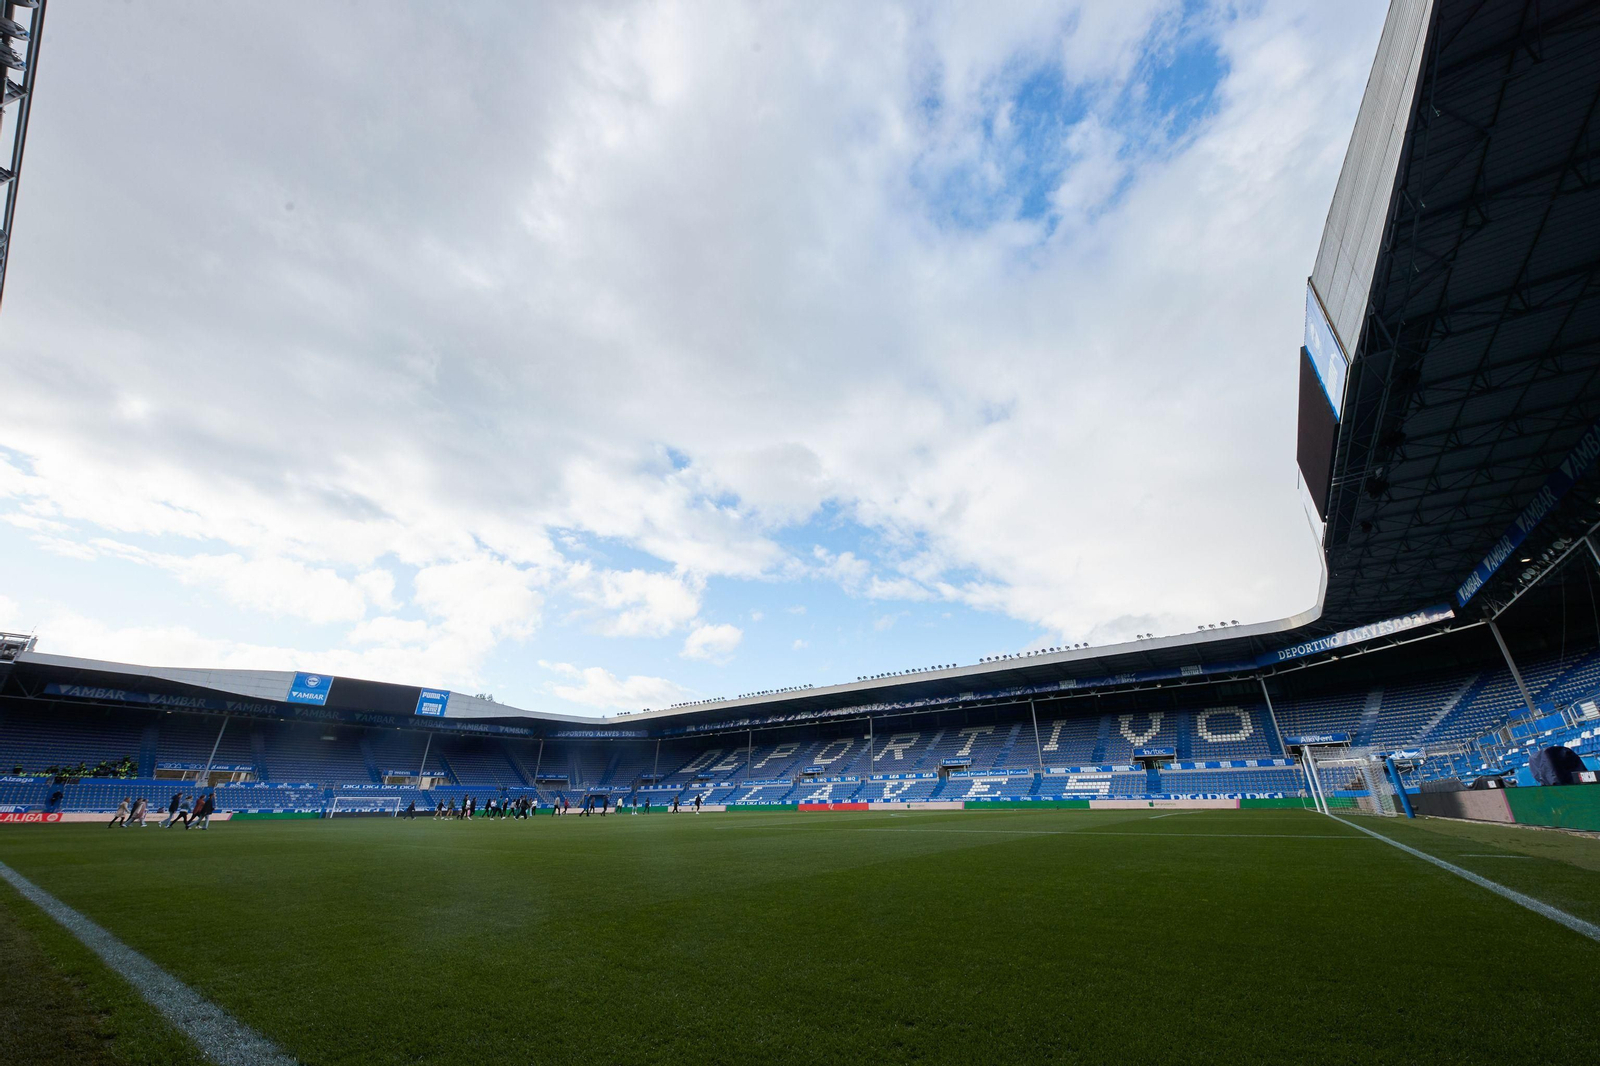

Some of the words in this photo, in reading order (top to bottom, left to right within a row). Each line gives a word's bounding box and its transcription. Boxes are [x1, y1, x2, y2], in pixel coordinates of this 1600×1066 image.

[1524, 485, 1558, 532] AMBAR
[1490, 535, 1515, 572] AMBAR
[1464, 571, 1483, 600] AMBAR
[1278, 636, 1340, 660] DEPORTIVO
[69, 686, 126, 700] AMBAR
[297, 692, 324, 700] AMBAR
[422, 691, 441, 699] PUMA
[158, 695, 206, 707] AMBAR
[233, 702, 277, 714] AMBAR
[301, 709, 339, 719] AMBAR
[361, 715, 395, 724] AMBAR
[414, 718, 445, 728] AMBAR
[461, 723, 488, 732] AMBAR
[503, 726, 529, 735] AMBAR
